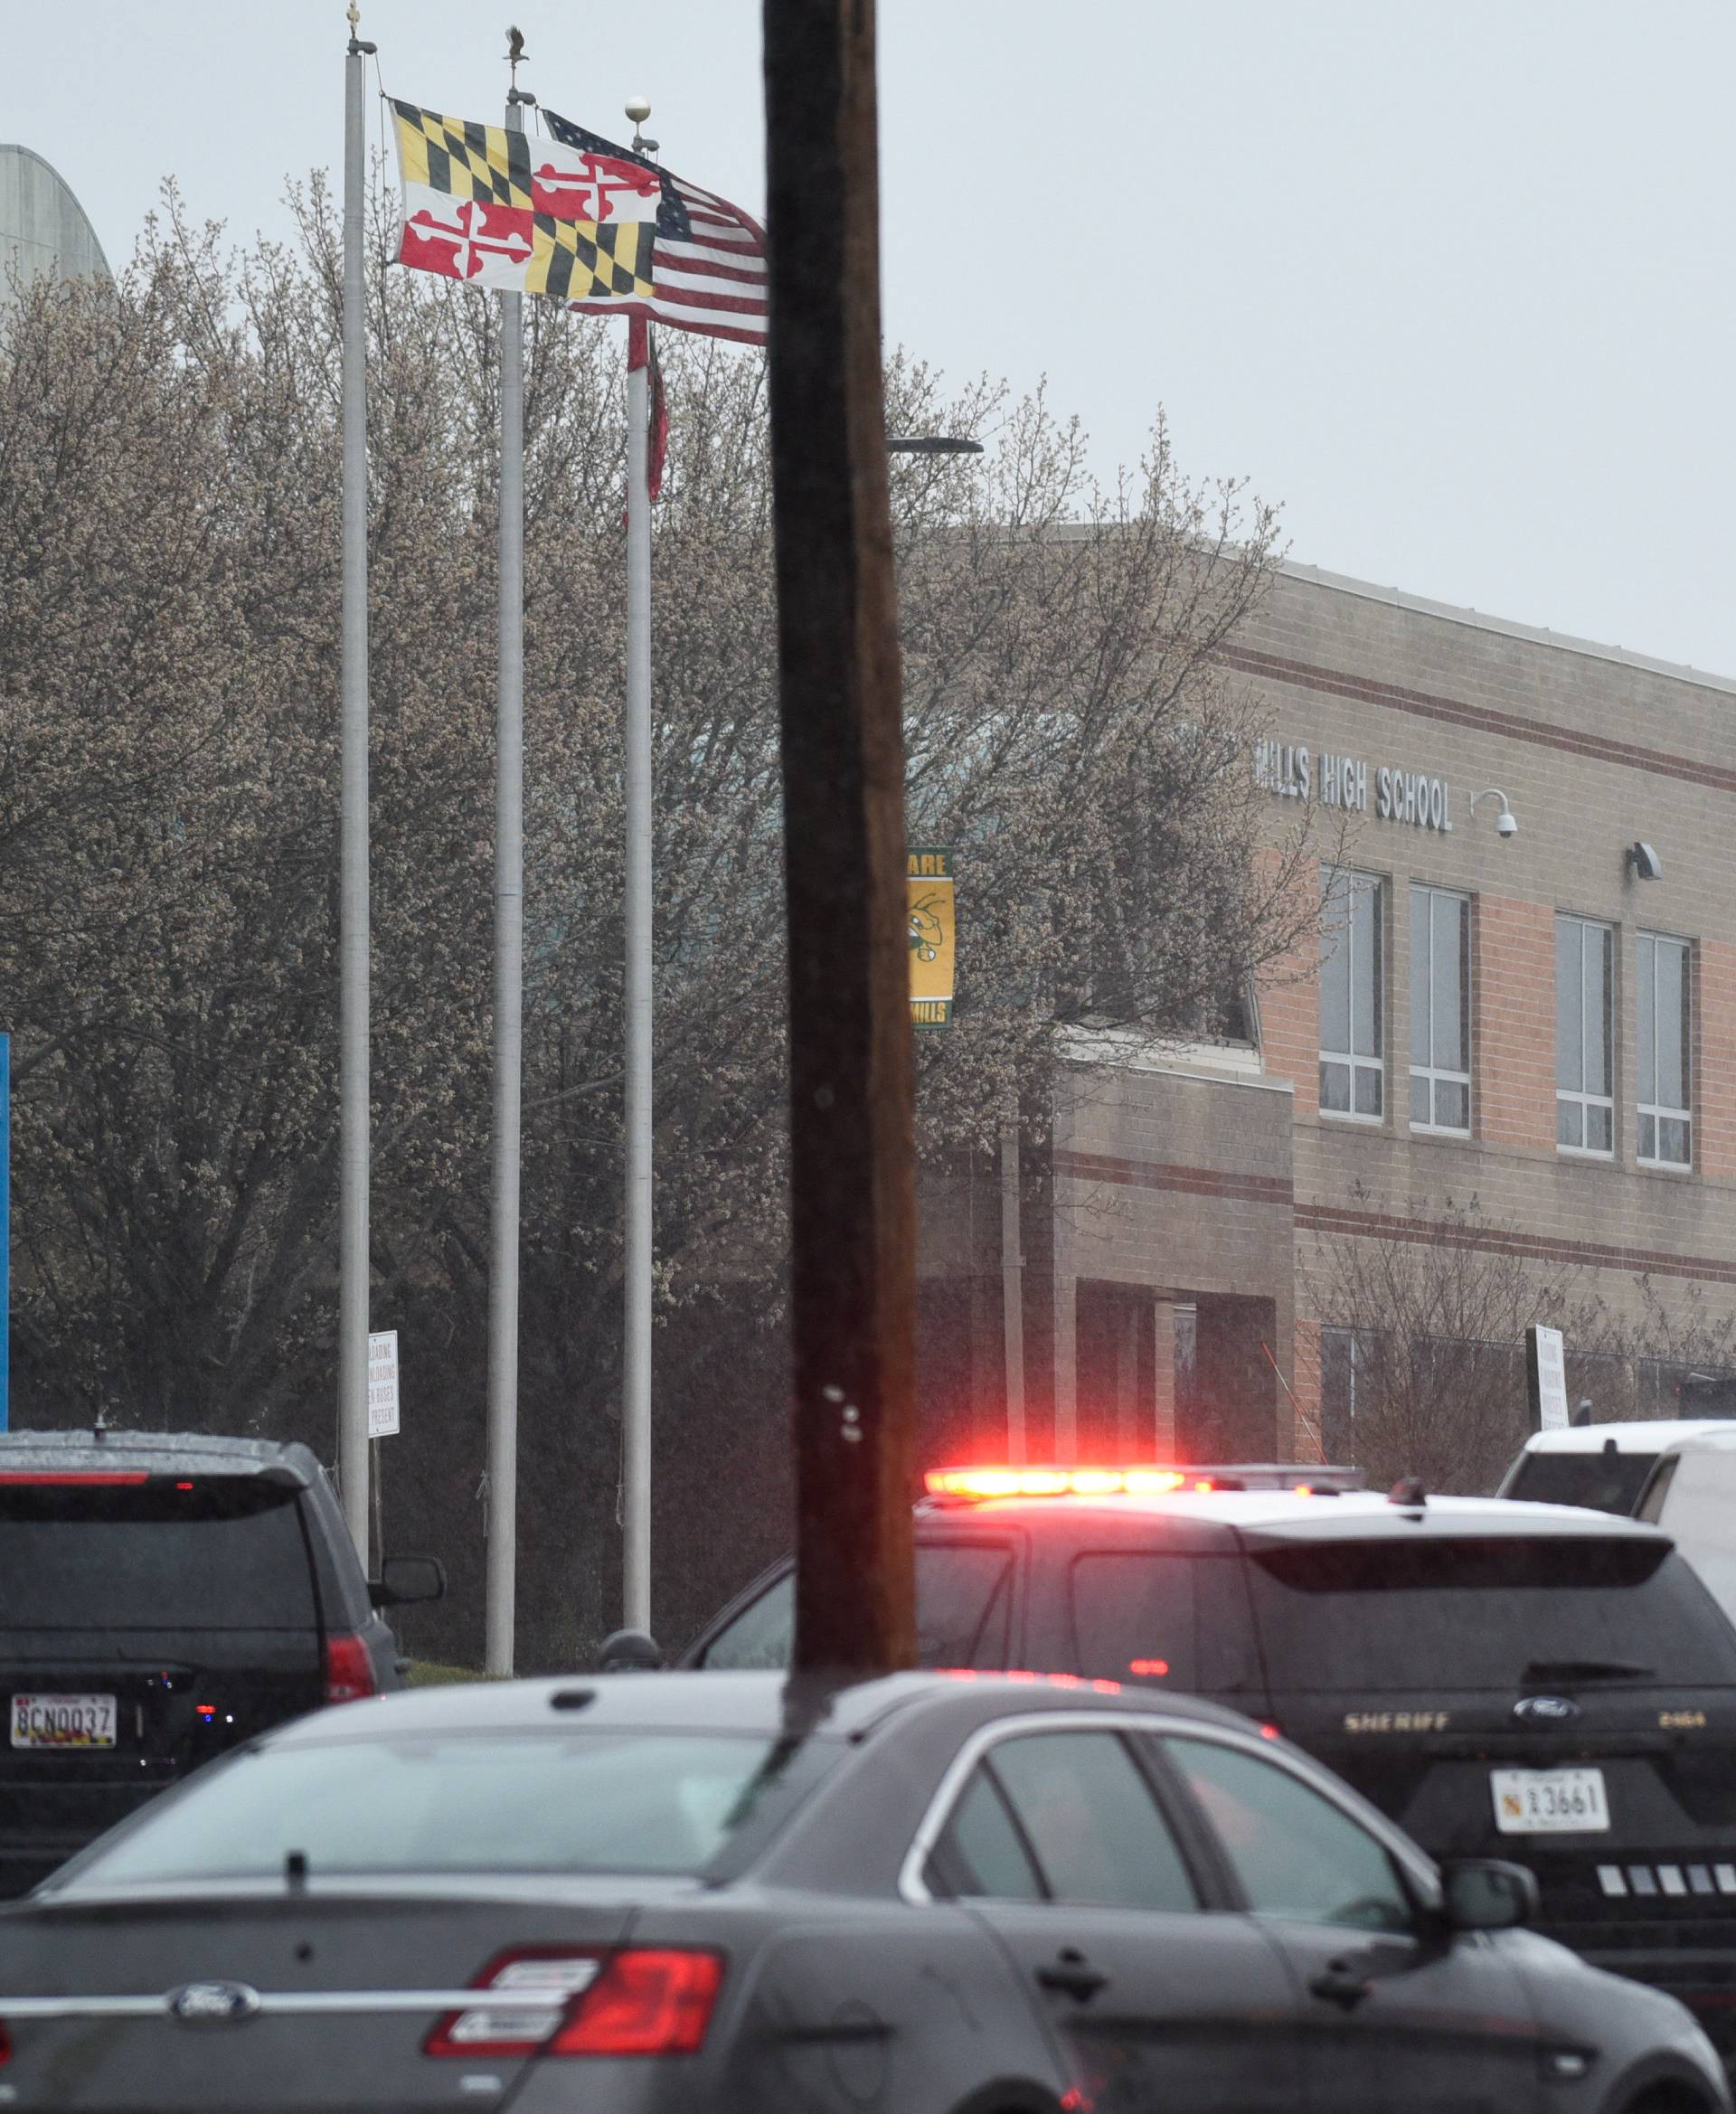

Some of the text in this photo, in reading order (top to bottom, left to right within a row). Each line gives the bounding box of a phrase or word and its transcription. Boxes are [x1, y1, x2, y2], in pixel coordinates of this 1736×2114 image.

[1321, 752, 1367, 811] HIGH
[1377, 766, 1453, 832] SCHOOL
[907, 854, 947, 875] ARE
[910, 1002, 946, 1024] MILLS
[369, 1364, 396, 1383] NLOADING
[376, 1385, 394, 1403] BUSES
[371, 1406, 394, 1426] PRESENT
[1344, 1711, 1449, 1733] SHERIFF
